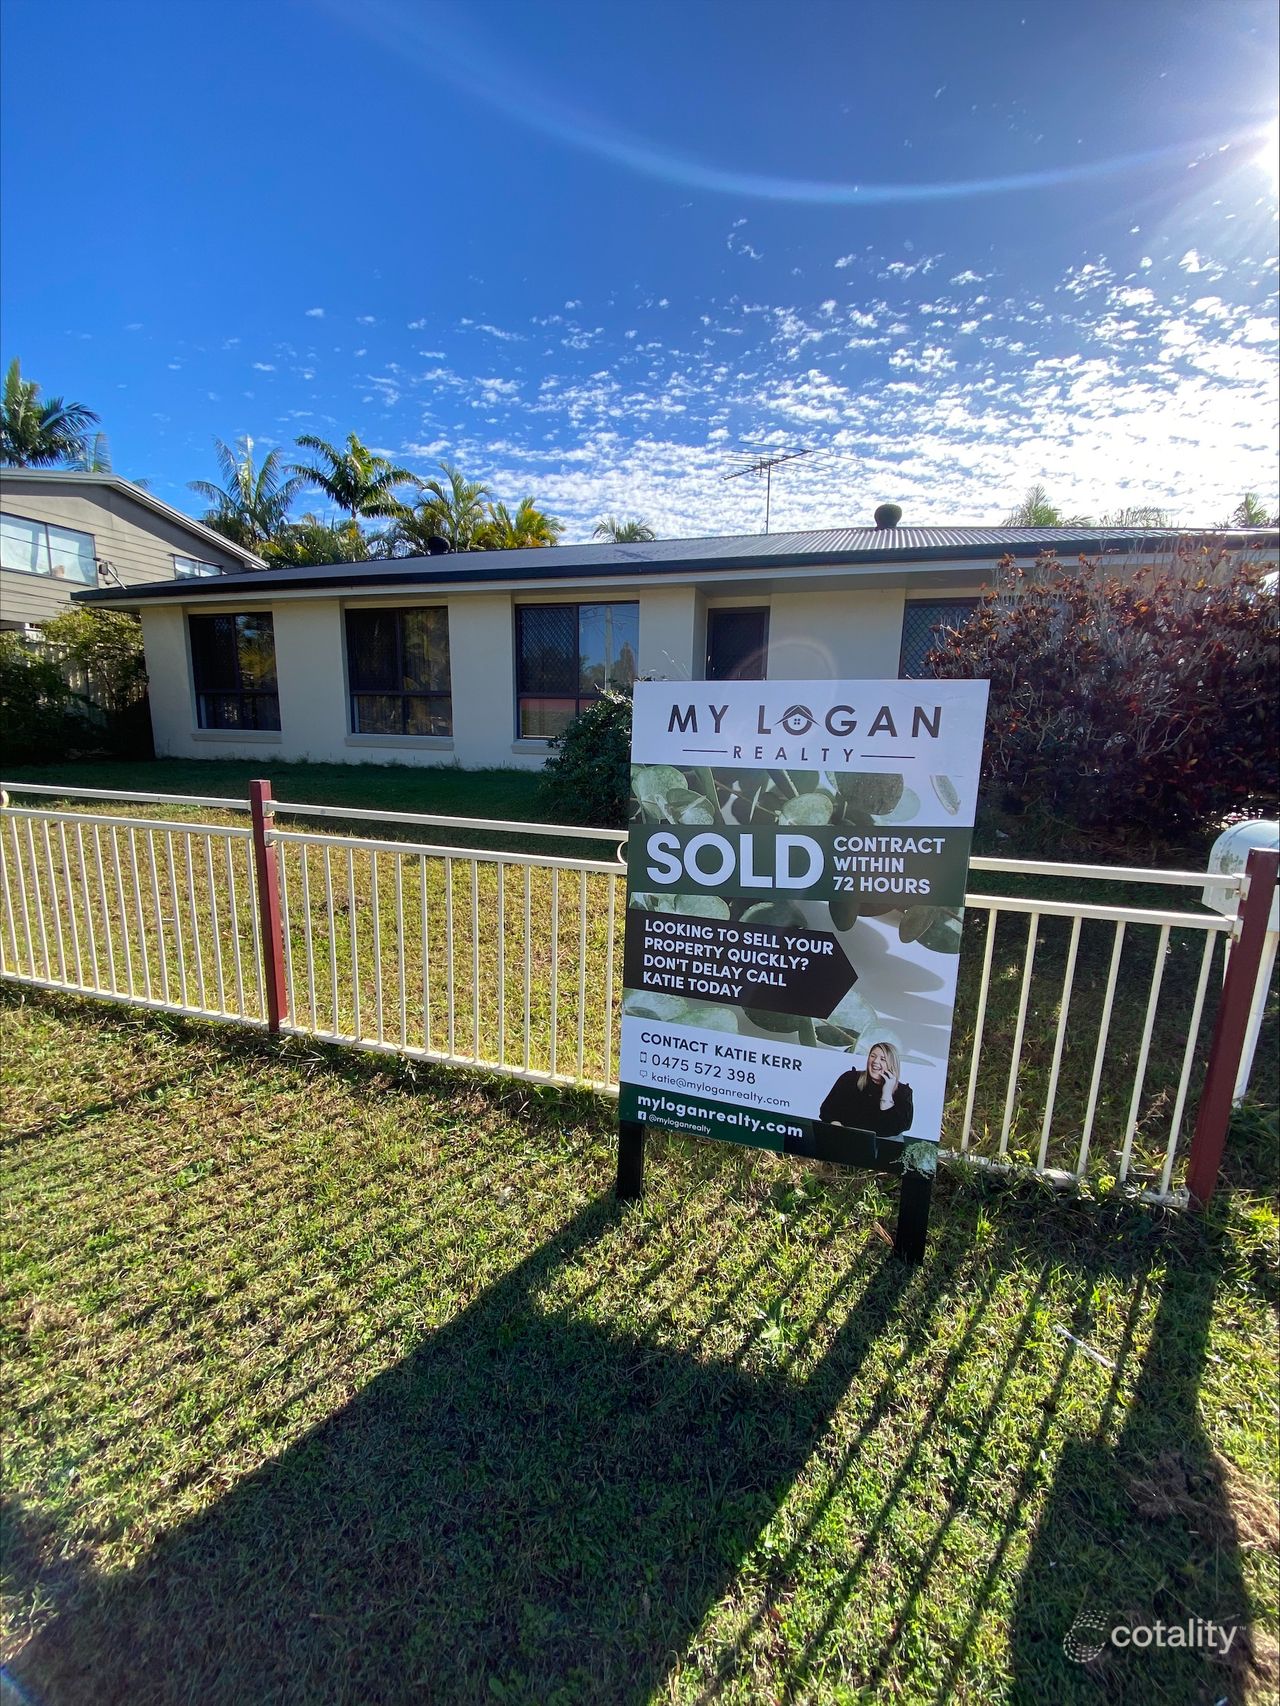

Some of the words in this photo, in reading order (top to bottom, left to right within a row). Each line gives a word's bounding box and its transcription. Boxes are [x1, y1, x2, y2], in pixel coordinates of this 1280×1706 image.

[668, 705, 729, 733] MY
[758, 704, 942, 738] LOGAN
[733, 746, 854, 762] REALTY
[646, 832, 825, 889] SOLD
[833, 836, 945, 853] CONTRACT
[833, 856, 904, 873] WITHIN
[833, 876, 853, 891] 72
[859, 877, 931, 894] HOURS
[644, 937, 725, 958] PROPERTY
[728, 948, 809, 971] QUICKLY?
[645, 920, 714, 940] LOOKING
[717, 928, 740, 942] TO
[743, 931, 780, 949] SELL
[784, 937, 833, 956] YOUR
[643, 954, 689, 972] DON'T
[692, 961, 743, 980] DELAY
[747, 969, 787, 987] CALL
[643, 972, 684, 989] KATIE
[688, 978, 742, 998] TODAY
[641, 1032, 708, 1054] CONTACT
[715, 1045, 757, 1063] KATIE
[761, 1054, 803, 1072] KERR
[651, 1054, 690, 1072] 0475
[694, 1062, 722, 1078] 572
[727, 1068, 756, 1085] 398
[651, 1072, 791, 1108] katie@myloganrealty.com
[637, 1094, 804, 1137] myloganrealty.com
[649, 1114, 711, 1135] @myloganrealty
